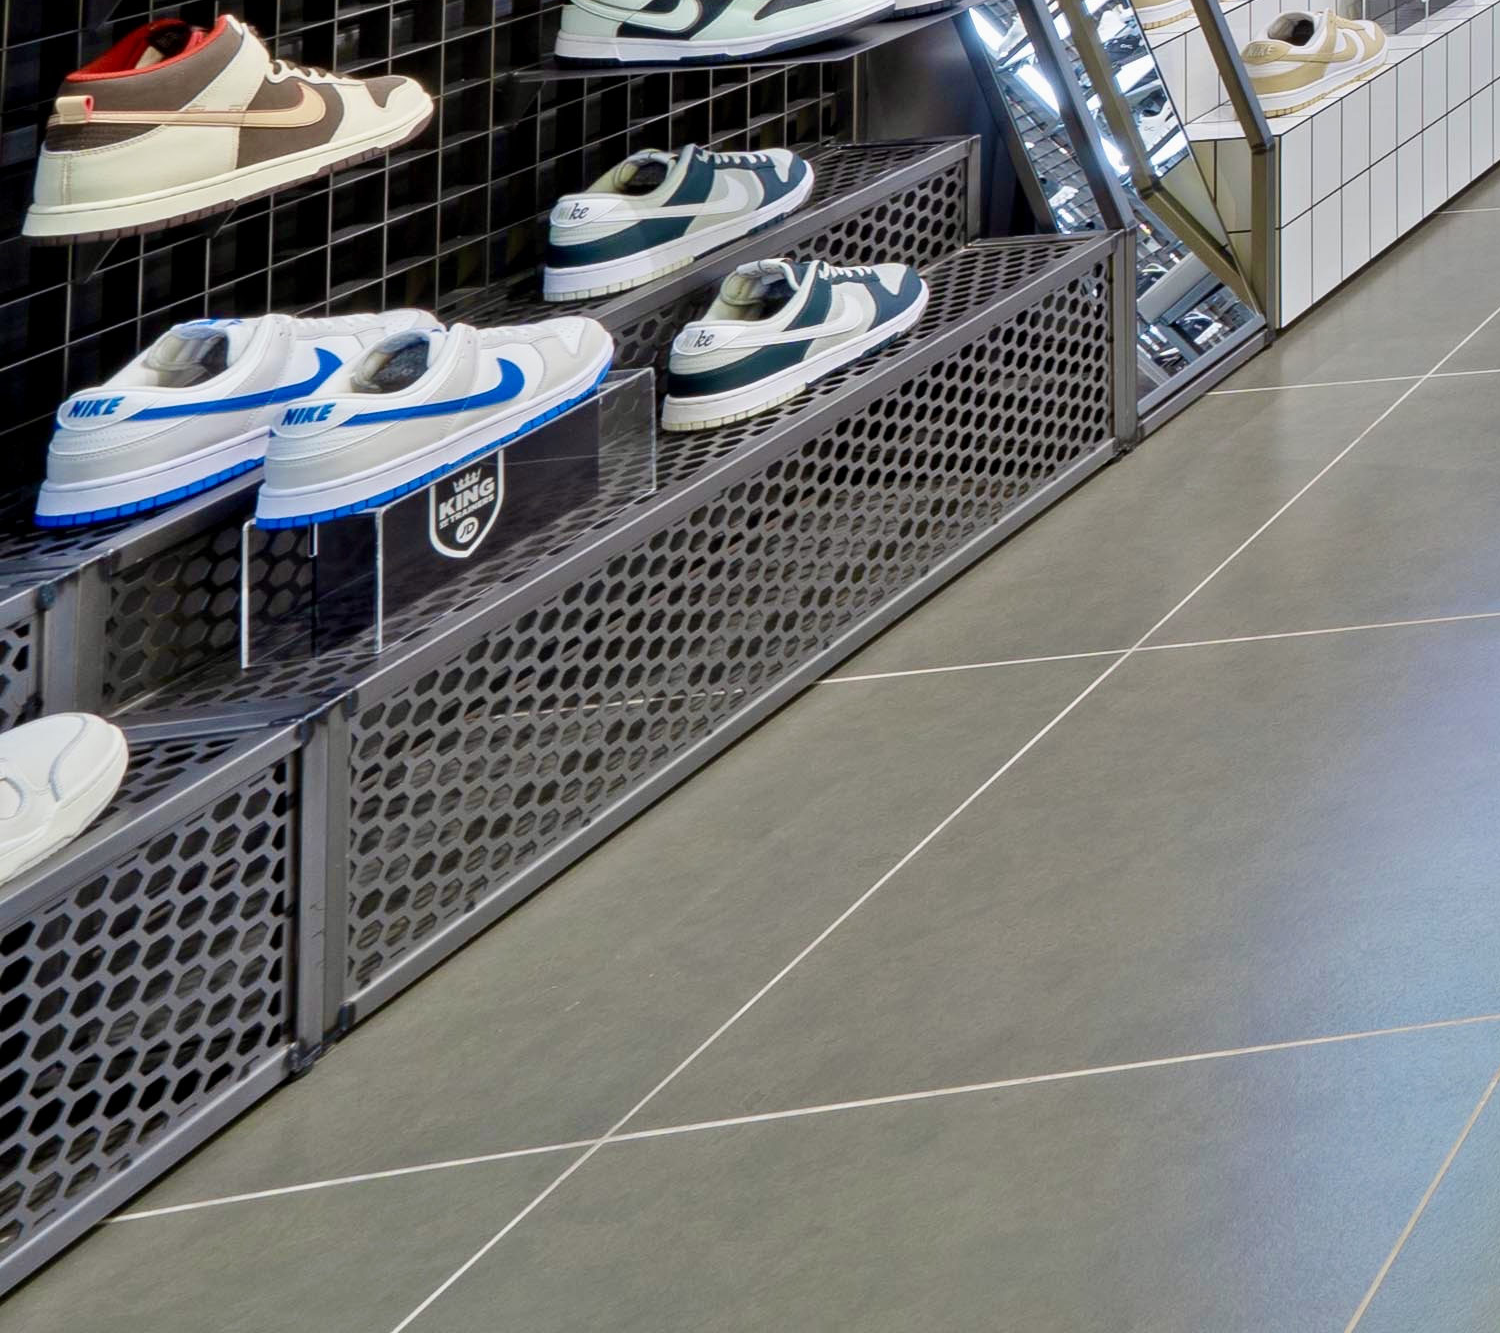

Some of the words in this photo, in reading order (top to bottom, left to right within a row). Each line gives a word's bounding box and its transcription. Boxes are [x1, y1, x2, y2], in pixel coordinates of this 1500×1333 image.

[67, 395, 125, 418] NIKE
[281, 402, 338, 426] NIKE
[439, 476, 496, 520] KING
